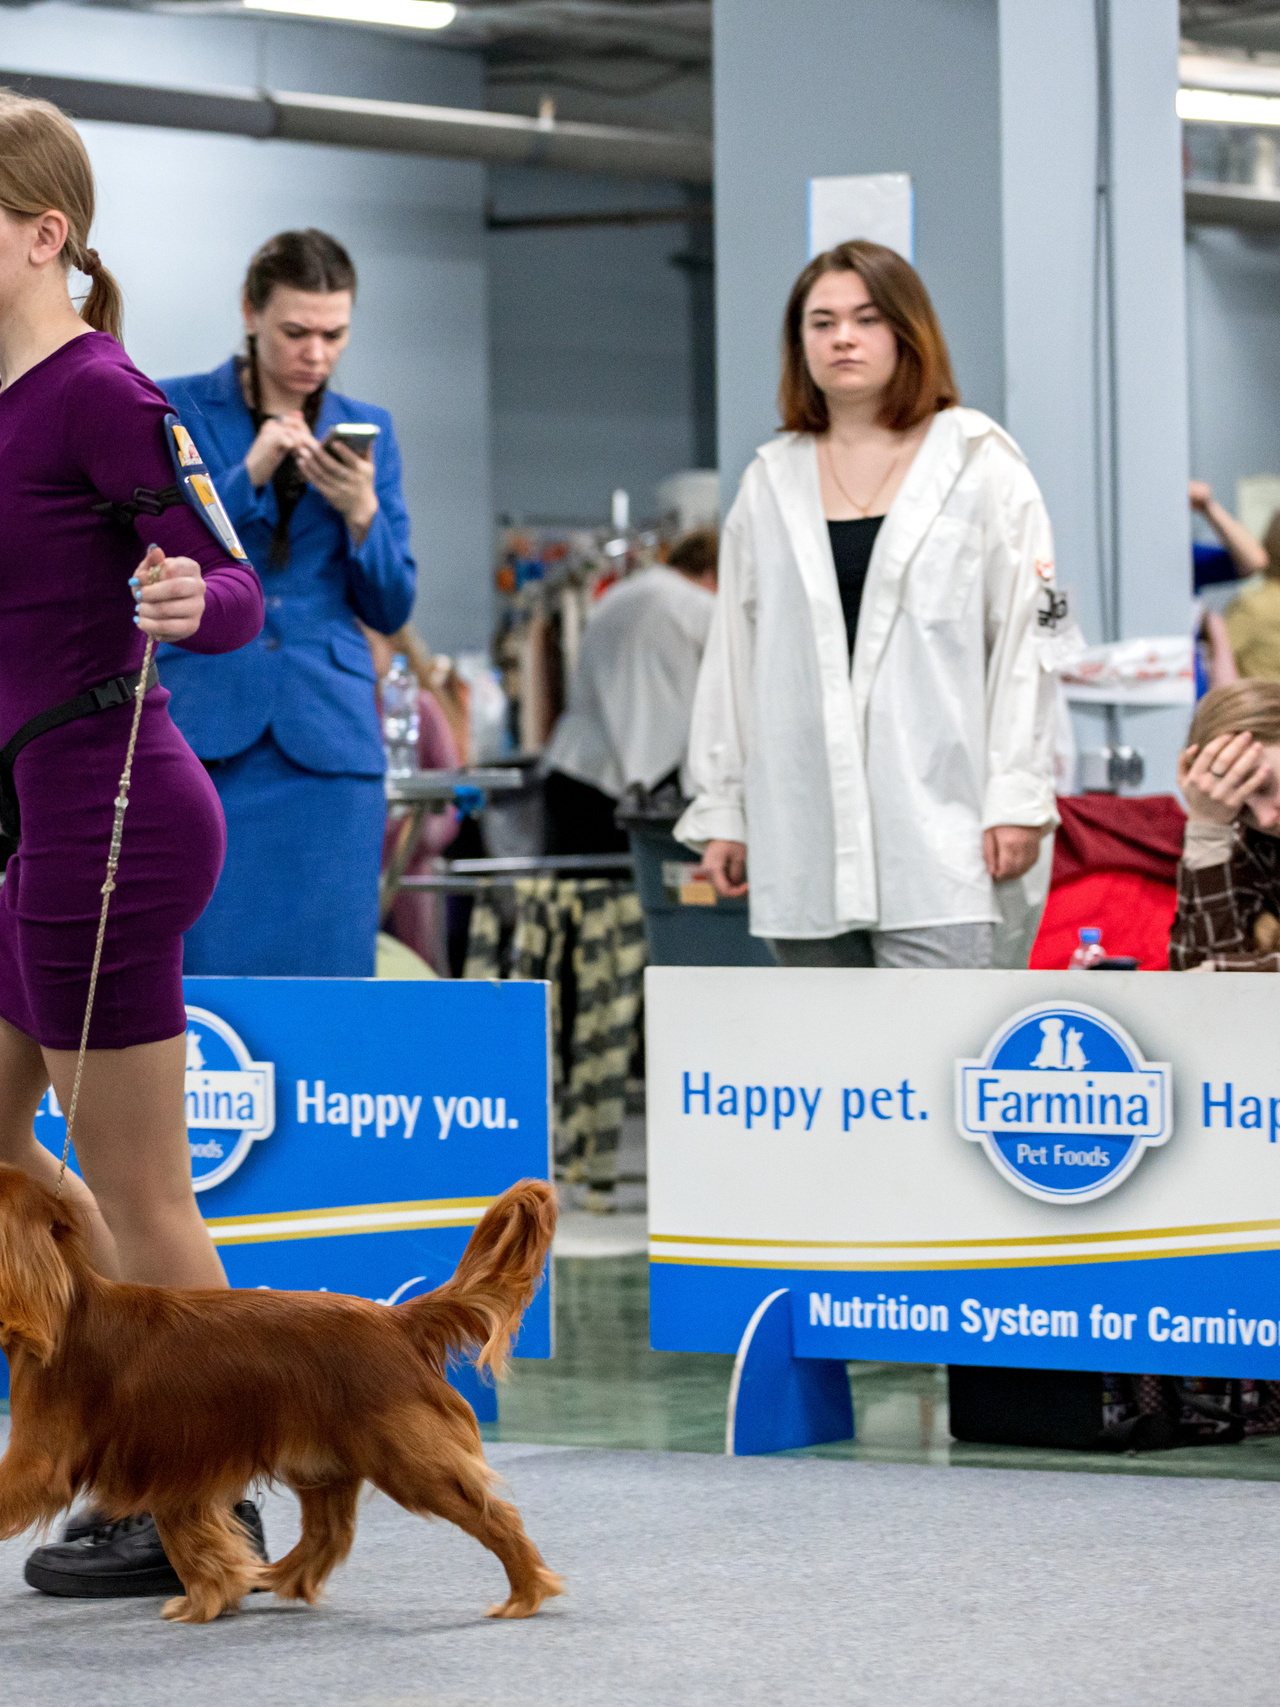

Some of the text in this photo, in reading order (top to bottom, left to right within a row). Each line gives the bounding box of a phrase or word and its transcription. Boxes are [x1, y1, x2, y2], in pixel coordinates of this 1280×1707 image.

[296, 1078, 519, 1140] Happy you.
[682, 1071, 928, 1132] Happy pet.
[977, 1078, 1149, 1126] Farmina
[1202, 1082, 1280, 1143] Hap
[189, 1138, 224, 1159] oods
[1016, 1143, 1111, 1167] Pet Foods
[809, 1291, 1280, 1347] Nutrition System for Carnivo
